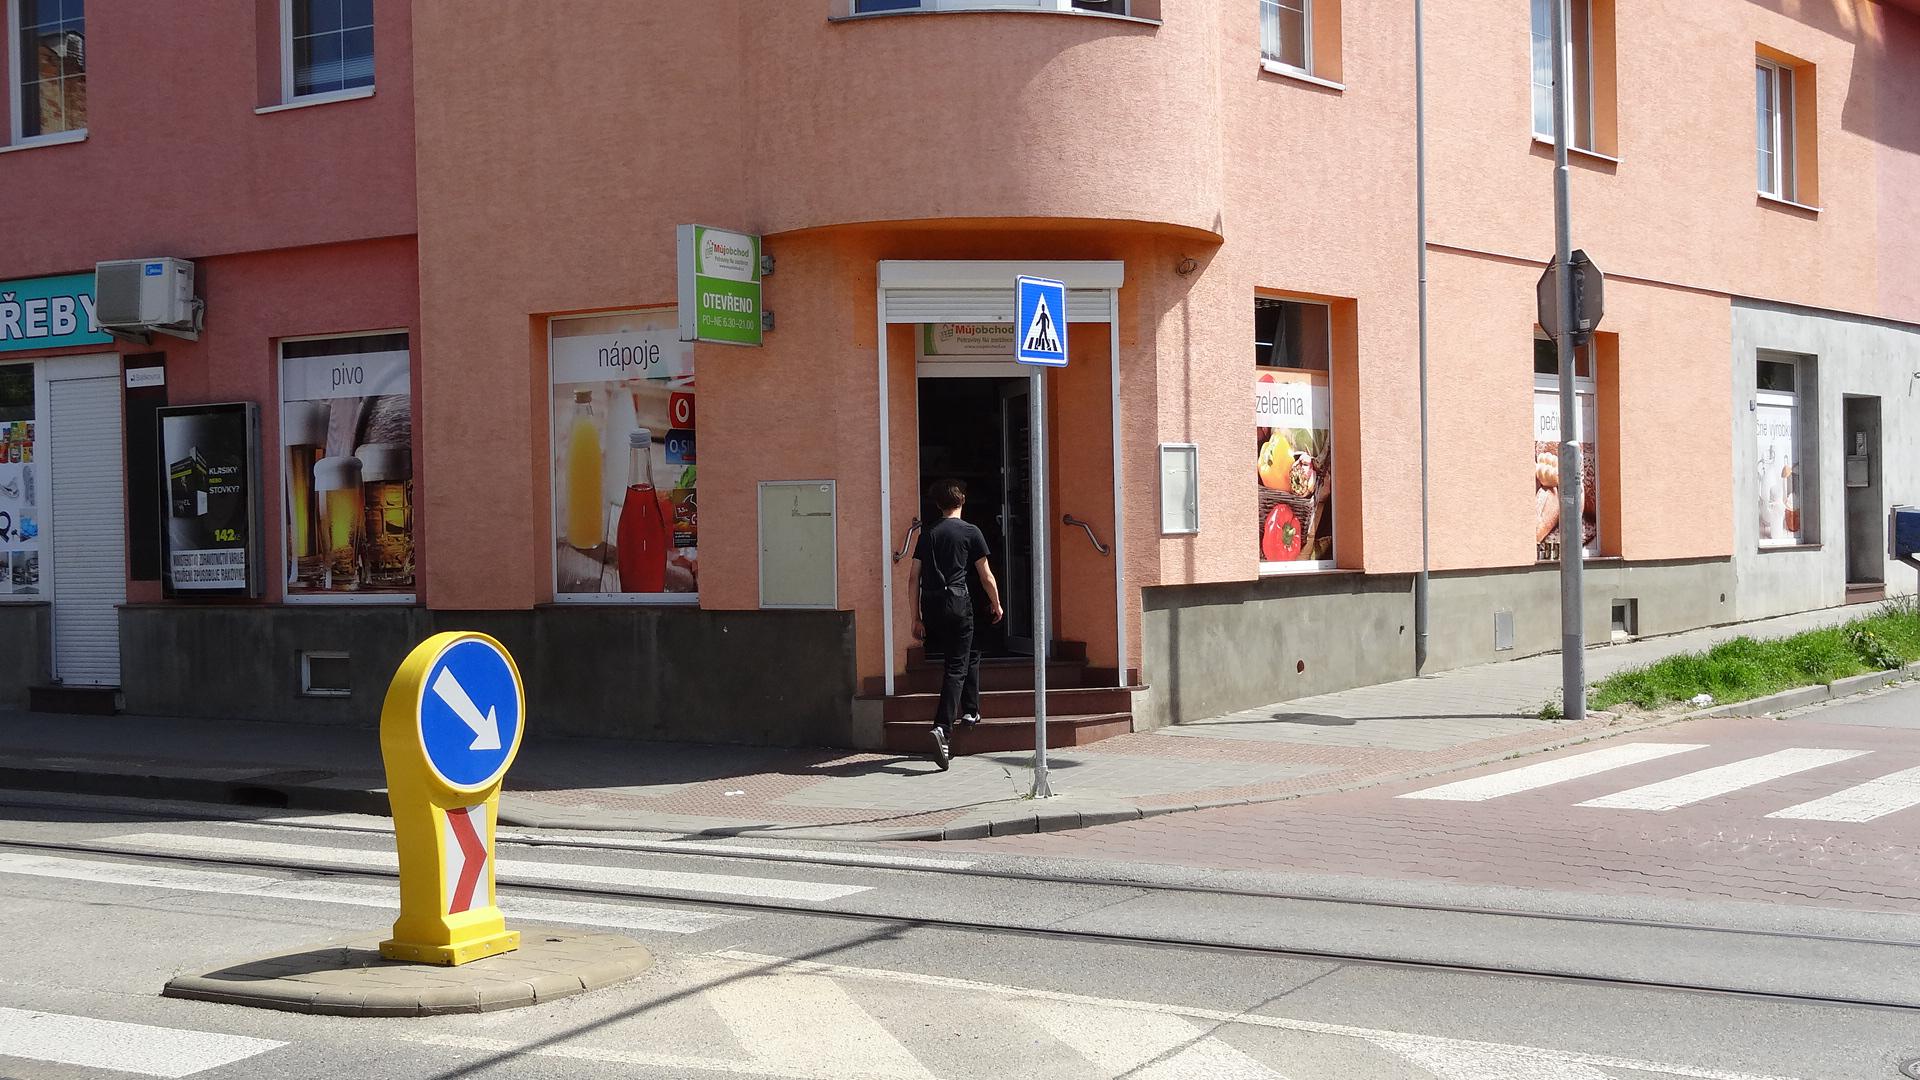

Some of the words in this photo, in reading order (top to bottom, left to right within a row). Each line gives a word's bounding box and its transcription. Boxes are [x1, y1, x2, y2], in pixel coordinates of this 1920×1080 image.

[703, 292, 753, 314] OTEVŘENO
[598, 339, 660, 371] nápoje
[332, 362, 364, 391] pivo
[1256, 390, 1304, 415] zelenina
[214, 529, 235, 541] 142
